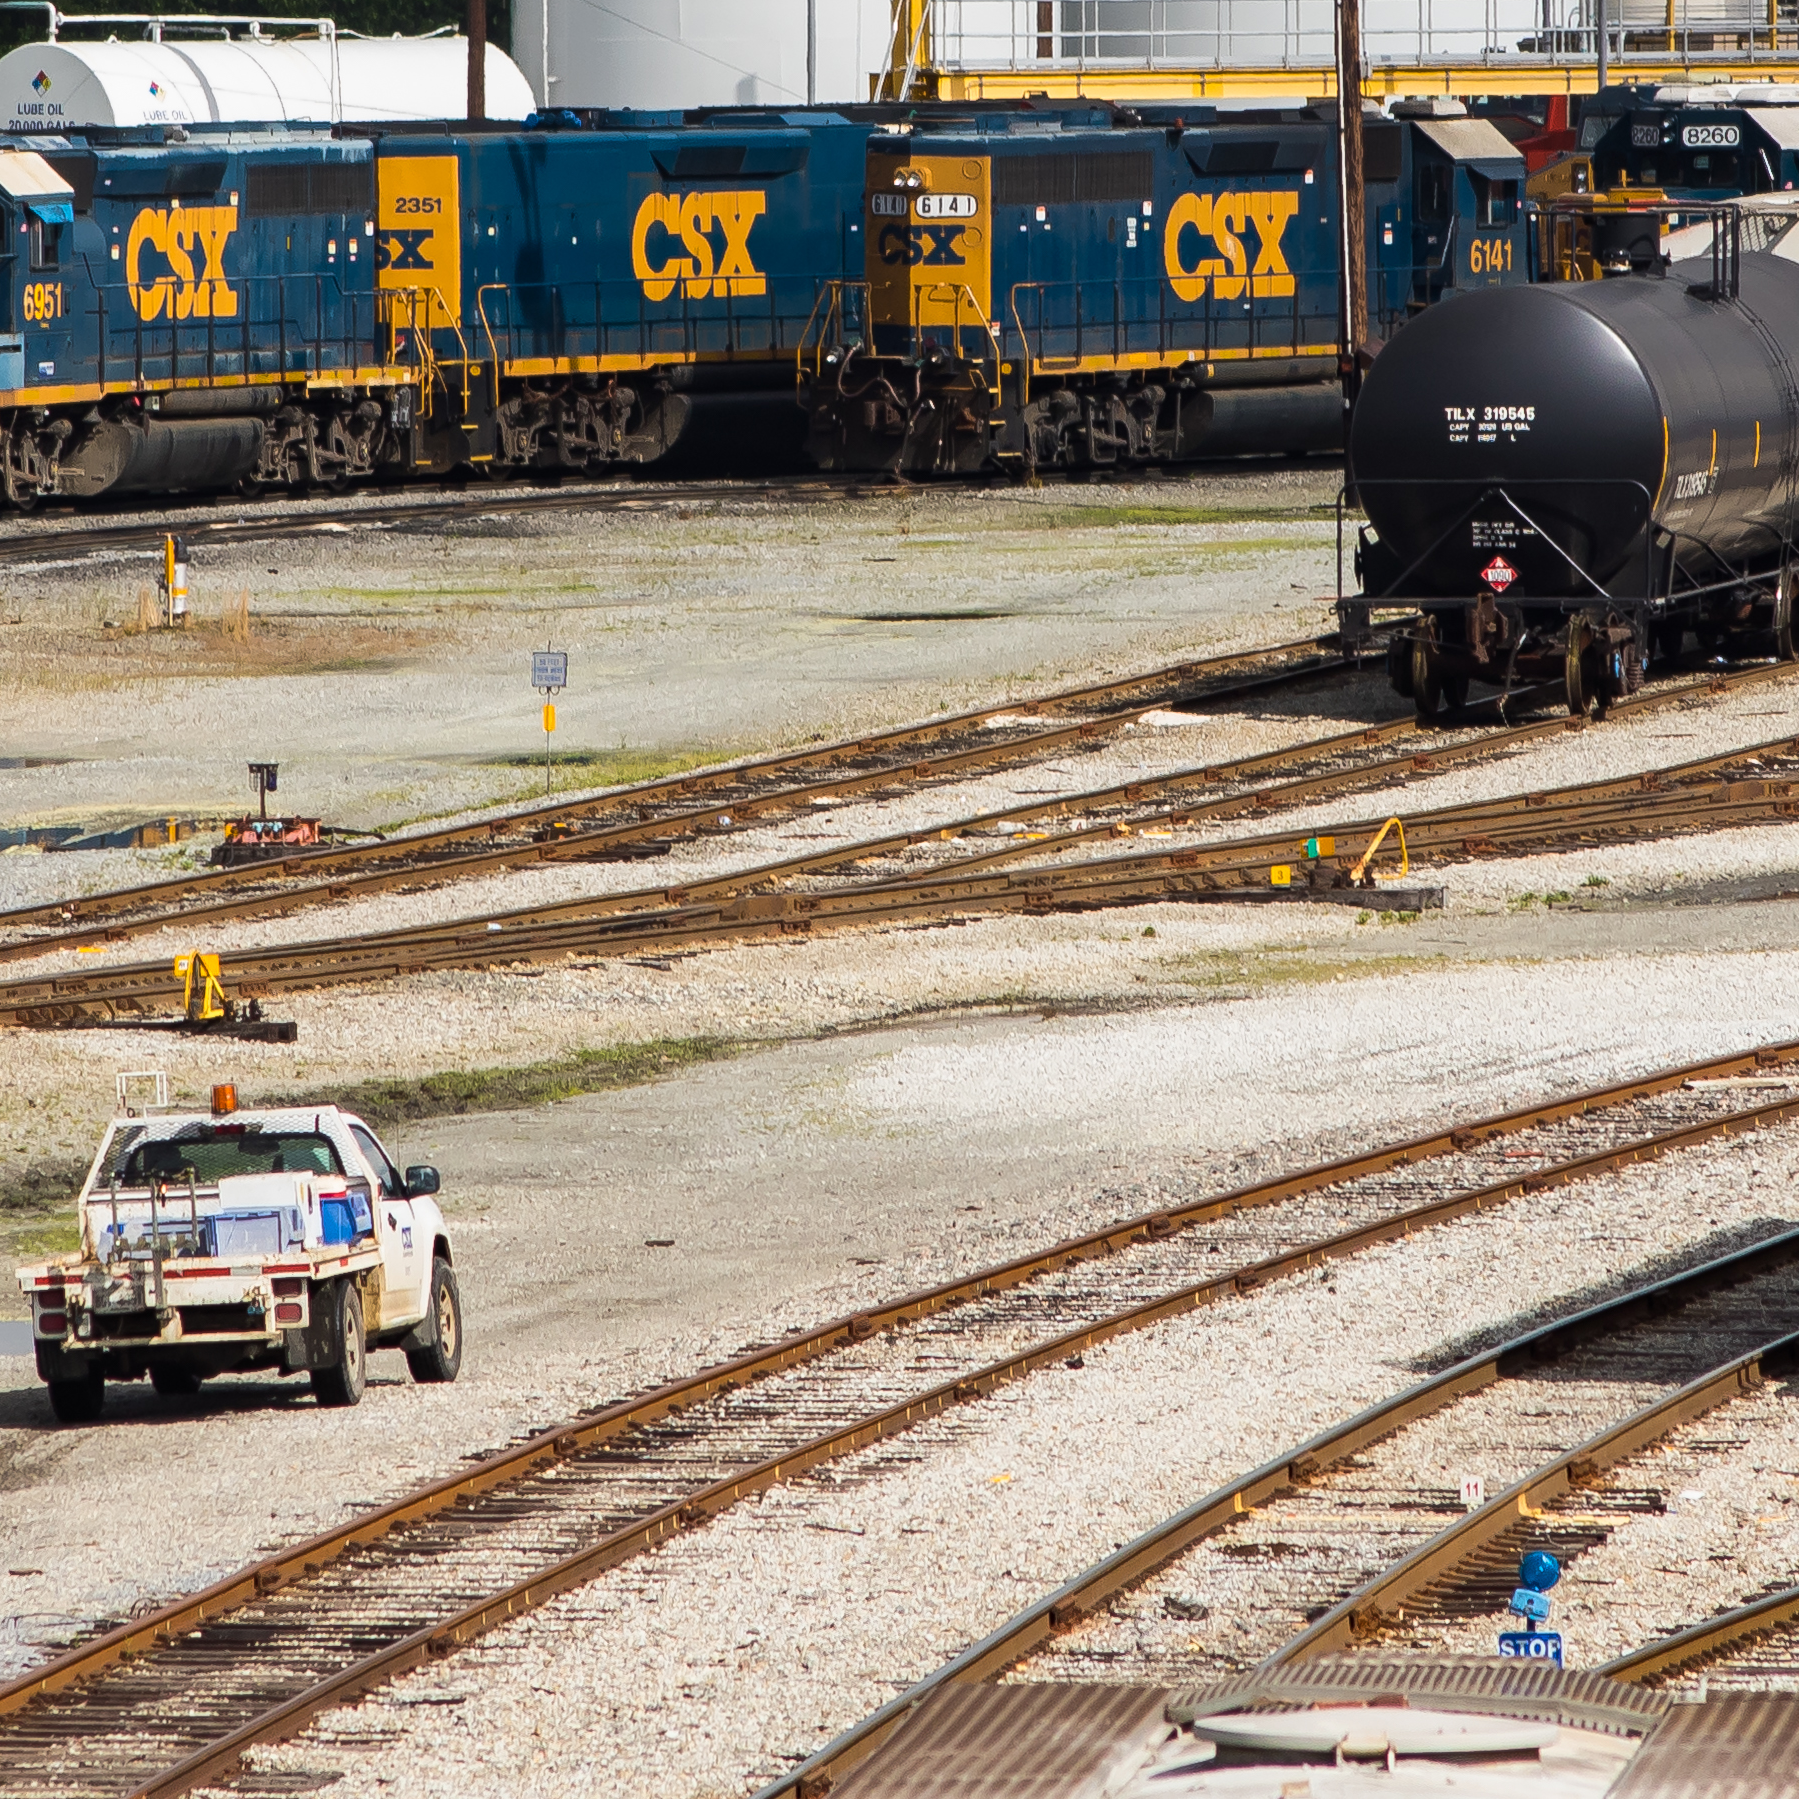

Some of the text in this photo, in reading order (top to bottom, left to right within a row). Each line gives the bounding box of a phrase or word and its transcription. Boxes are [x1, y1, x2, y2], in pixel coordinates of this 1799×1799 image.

[17, 103, 64, 116] LUBE OIL
[143, 110, 188, 121] LUBE OIL
[1687, 126, 1739, 146] 8260
[395, 197, 442, 215] 2351
[873, 196, 906, 215] 6141
[921, 196, 973, 216] 6141
[375, 229, 434, 270] SX
[631, 190, 767, 302] CSX
[878, 224, 966, 266] CSX
[1164, 190, 1299, 302] CSX
[126, 206, 238, 322] CSX
[1469, 239, 1513, 273] 6141
[23, 284, 62, 322] 6951
[1445, 407, 1535, 421] TILX 319545
[1277, 871, 1283, 880] 3
[1466, 1482, 1478, 1497] 11
[1499, 1640, 1559, 1659] STOP
